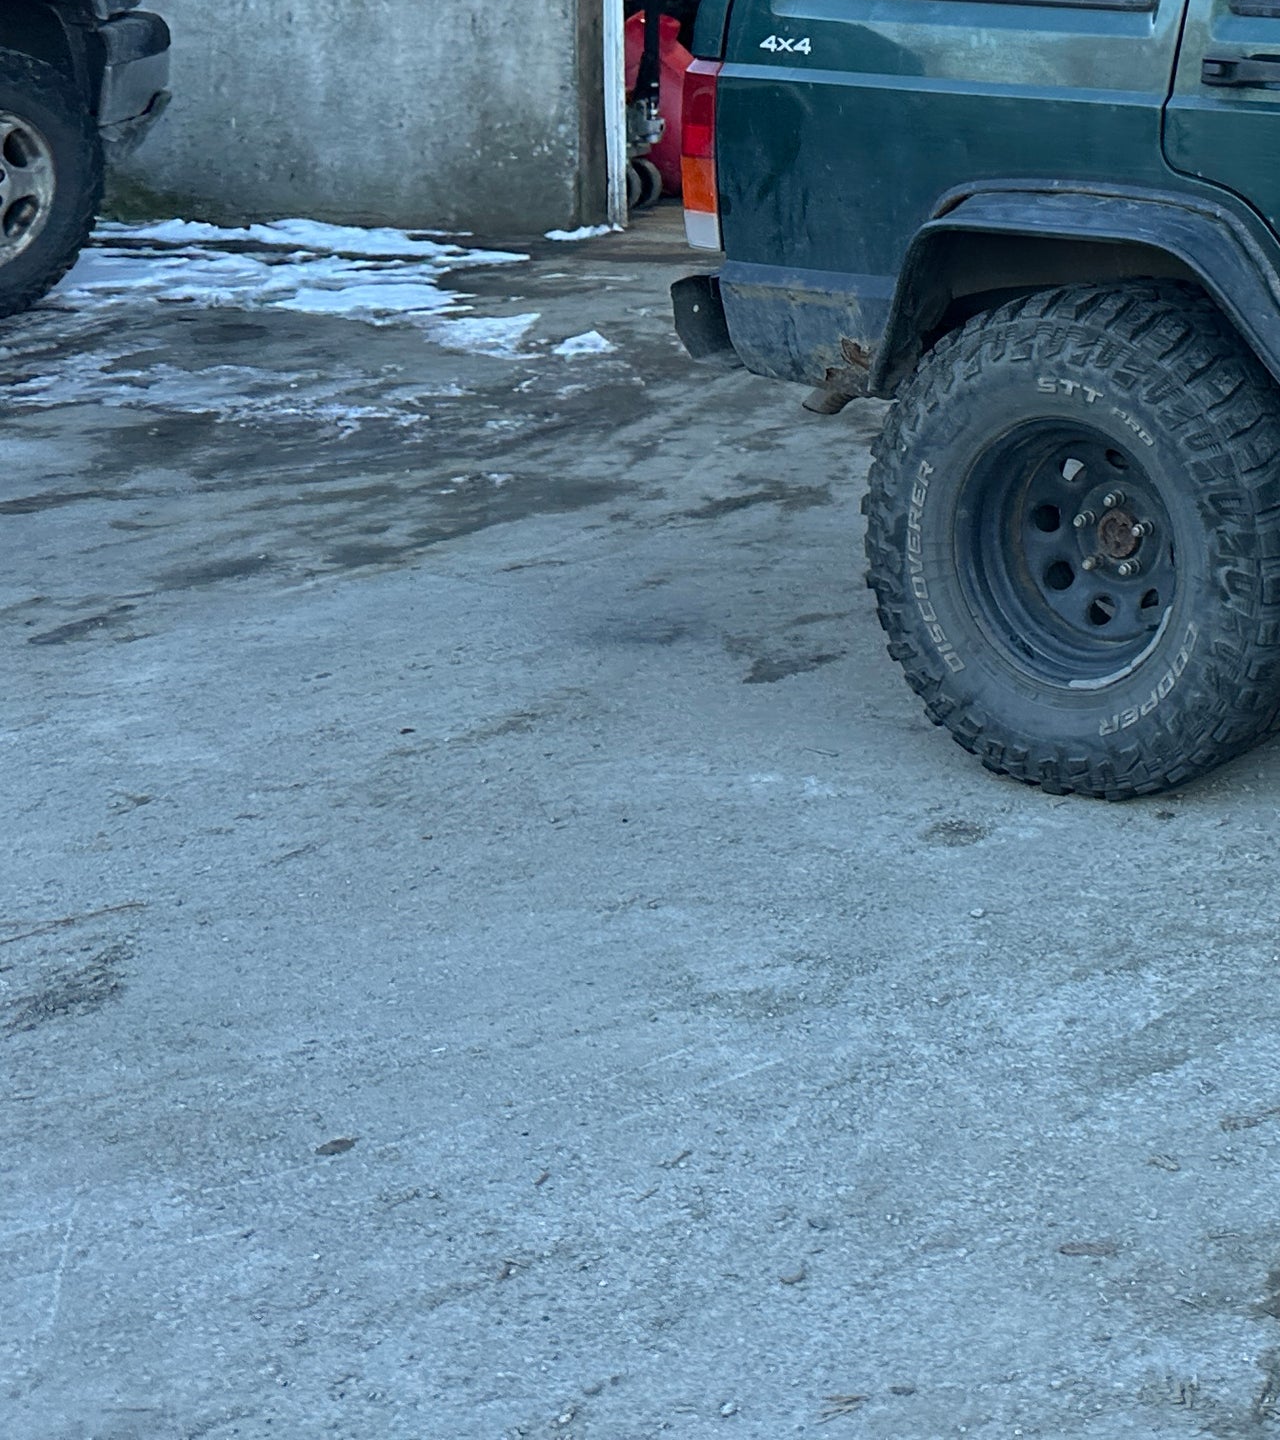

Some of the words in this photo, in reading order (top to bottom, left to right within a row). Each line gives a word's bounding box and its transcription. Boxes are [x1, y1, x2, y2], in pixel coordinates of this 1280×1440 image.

[1037, 376, 1104, 405] STT
[1111, 406, 1156, 448] PRO
[905, 460, 966, 674] DISCOVERER
[1099, 621, 1200, 737] COOPER
